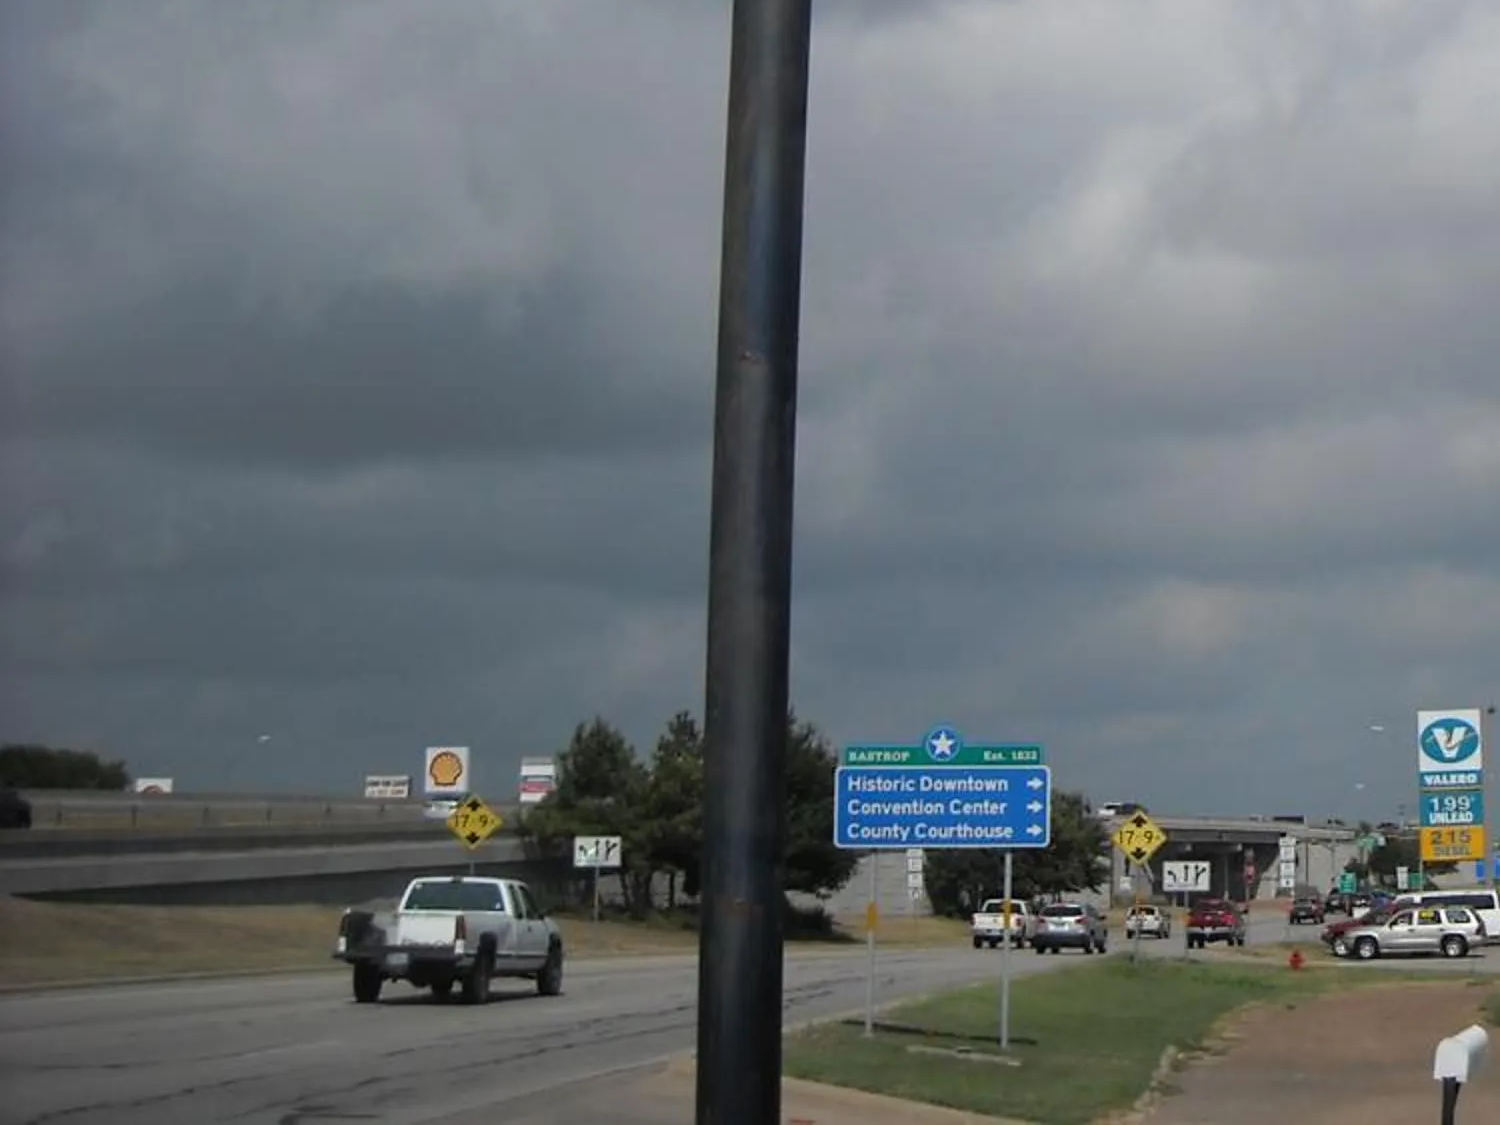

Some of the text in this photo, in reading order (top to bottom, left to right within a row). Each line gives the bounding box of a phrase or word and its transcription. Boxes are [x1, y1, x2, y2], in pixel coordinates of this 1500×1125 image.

[849, 750, 911, 763] BASTROP
[847, 777, 1009, 792] Historic Downtown
[1423, 774, 1478, 786] VALERO
[847, 798, 1008, 815] Convention Center
[1429, 811, 1473, 824] UNLEAD
[847, 821, 1014, 840] County Courthouse
